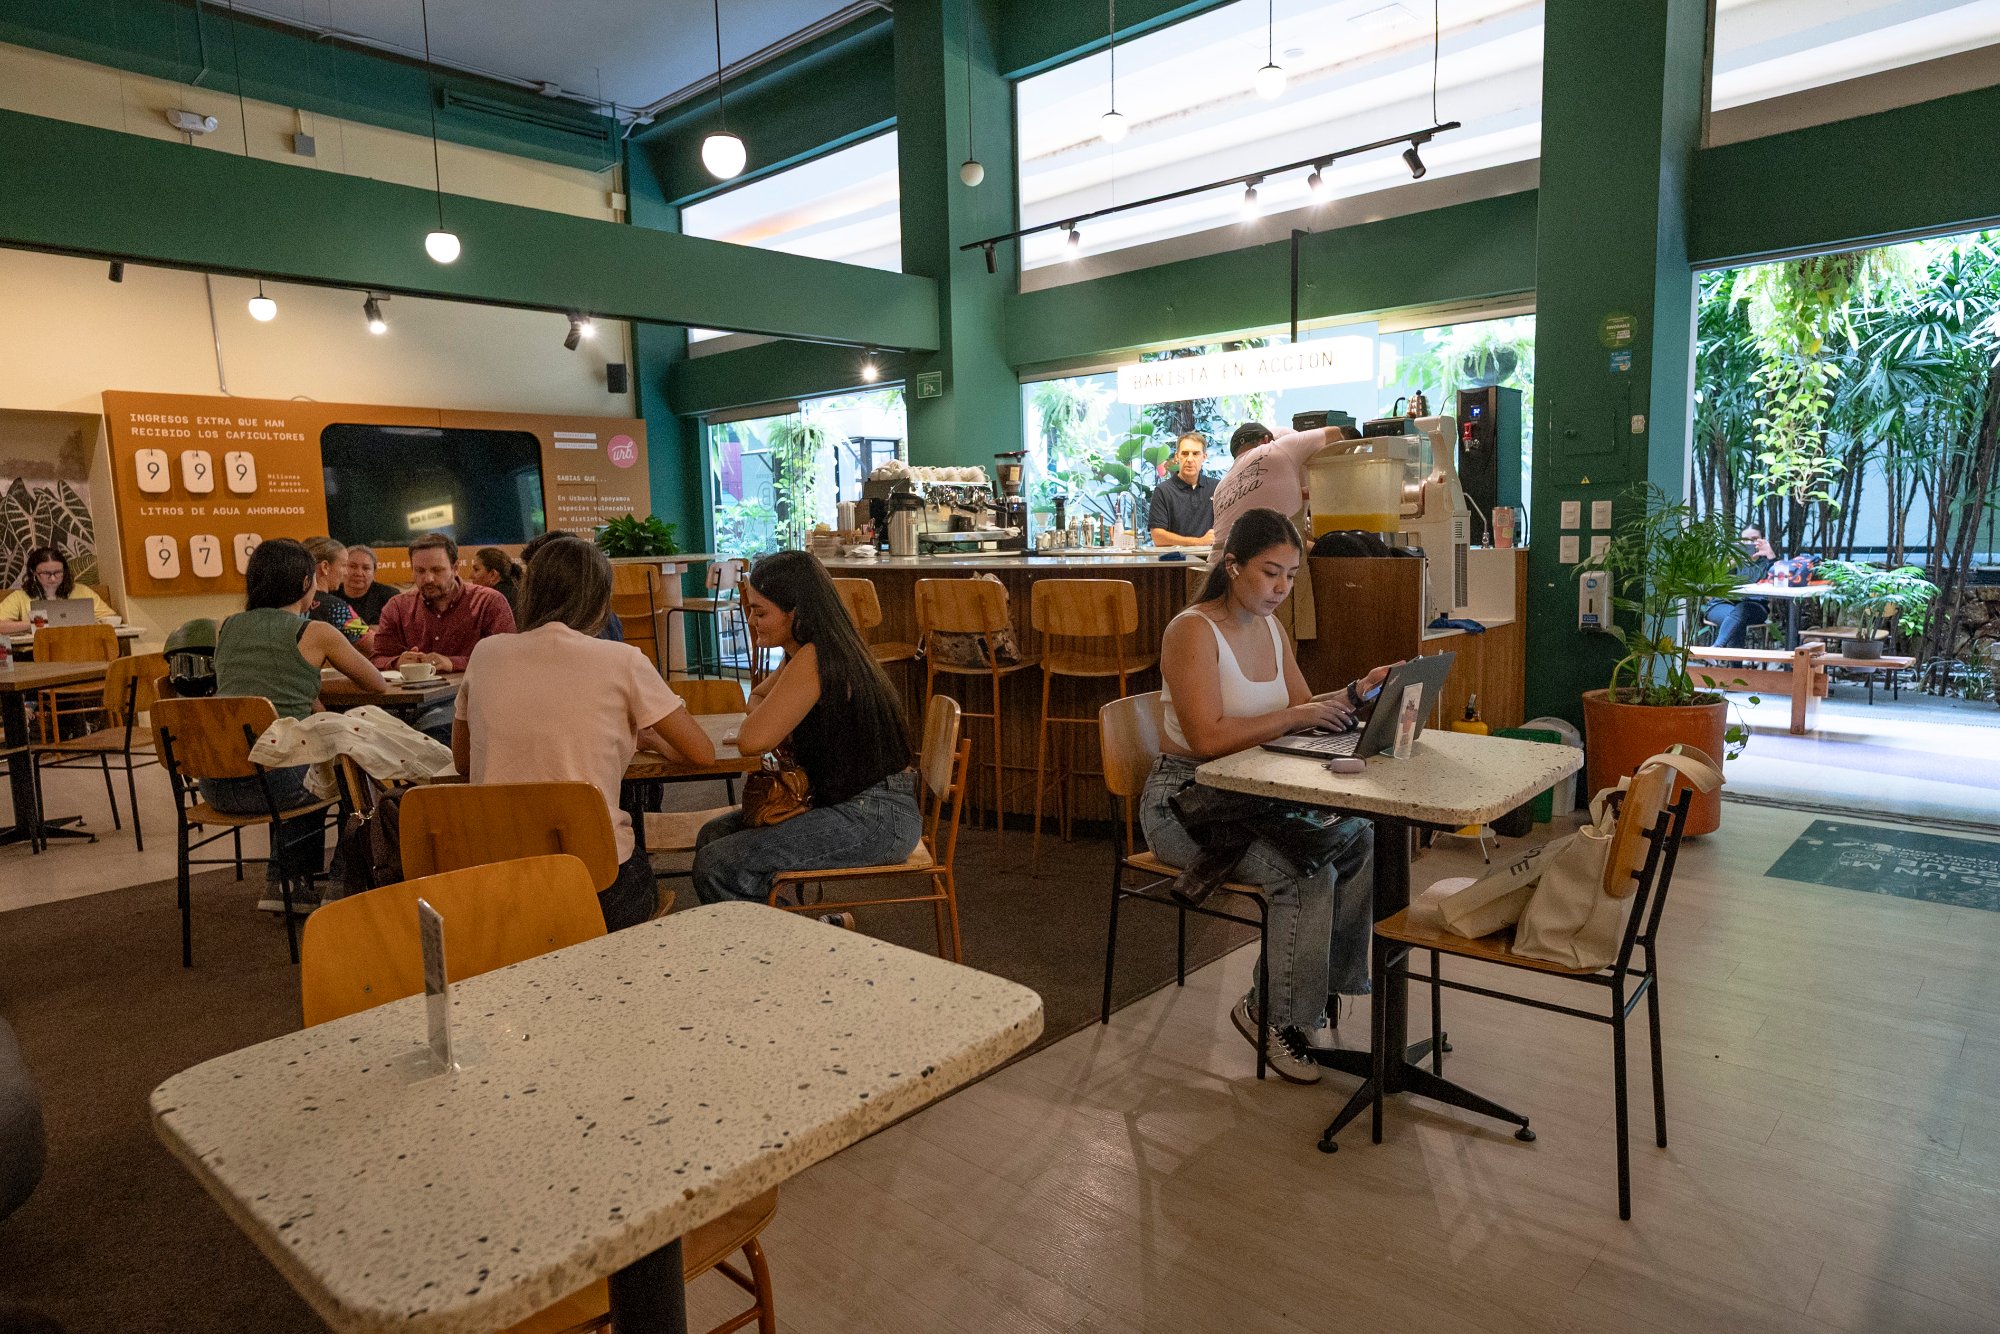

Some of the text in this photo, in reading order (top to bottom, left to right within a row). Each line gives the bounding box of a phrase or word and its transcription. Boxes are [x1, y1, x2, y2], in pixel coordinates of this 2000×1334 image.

[1133, 350, 1333, 390] BARISTA EN ACCION
[130, 413, 285, 428] INGRESOS EXTRA QUE HAN
[131, 427, 305, 441] RECIBIDO LOS CAFICULTORES
[140, 506, 305, 516] LITROS DE AGUA AHORRADOS
[159, 548, 211, 566] 9 7
[376, 561, 397, 569] CAFE
